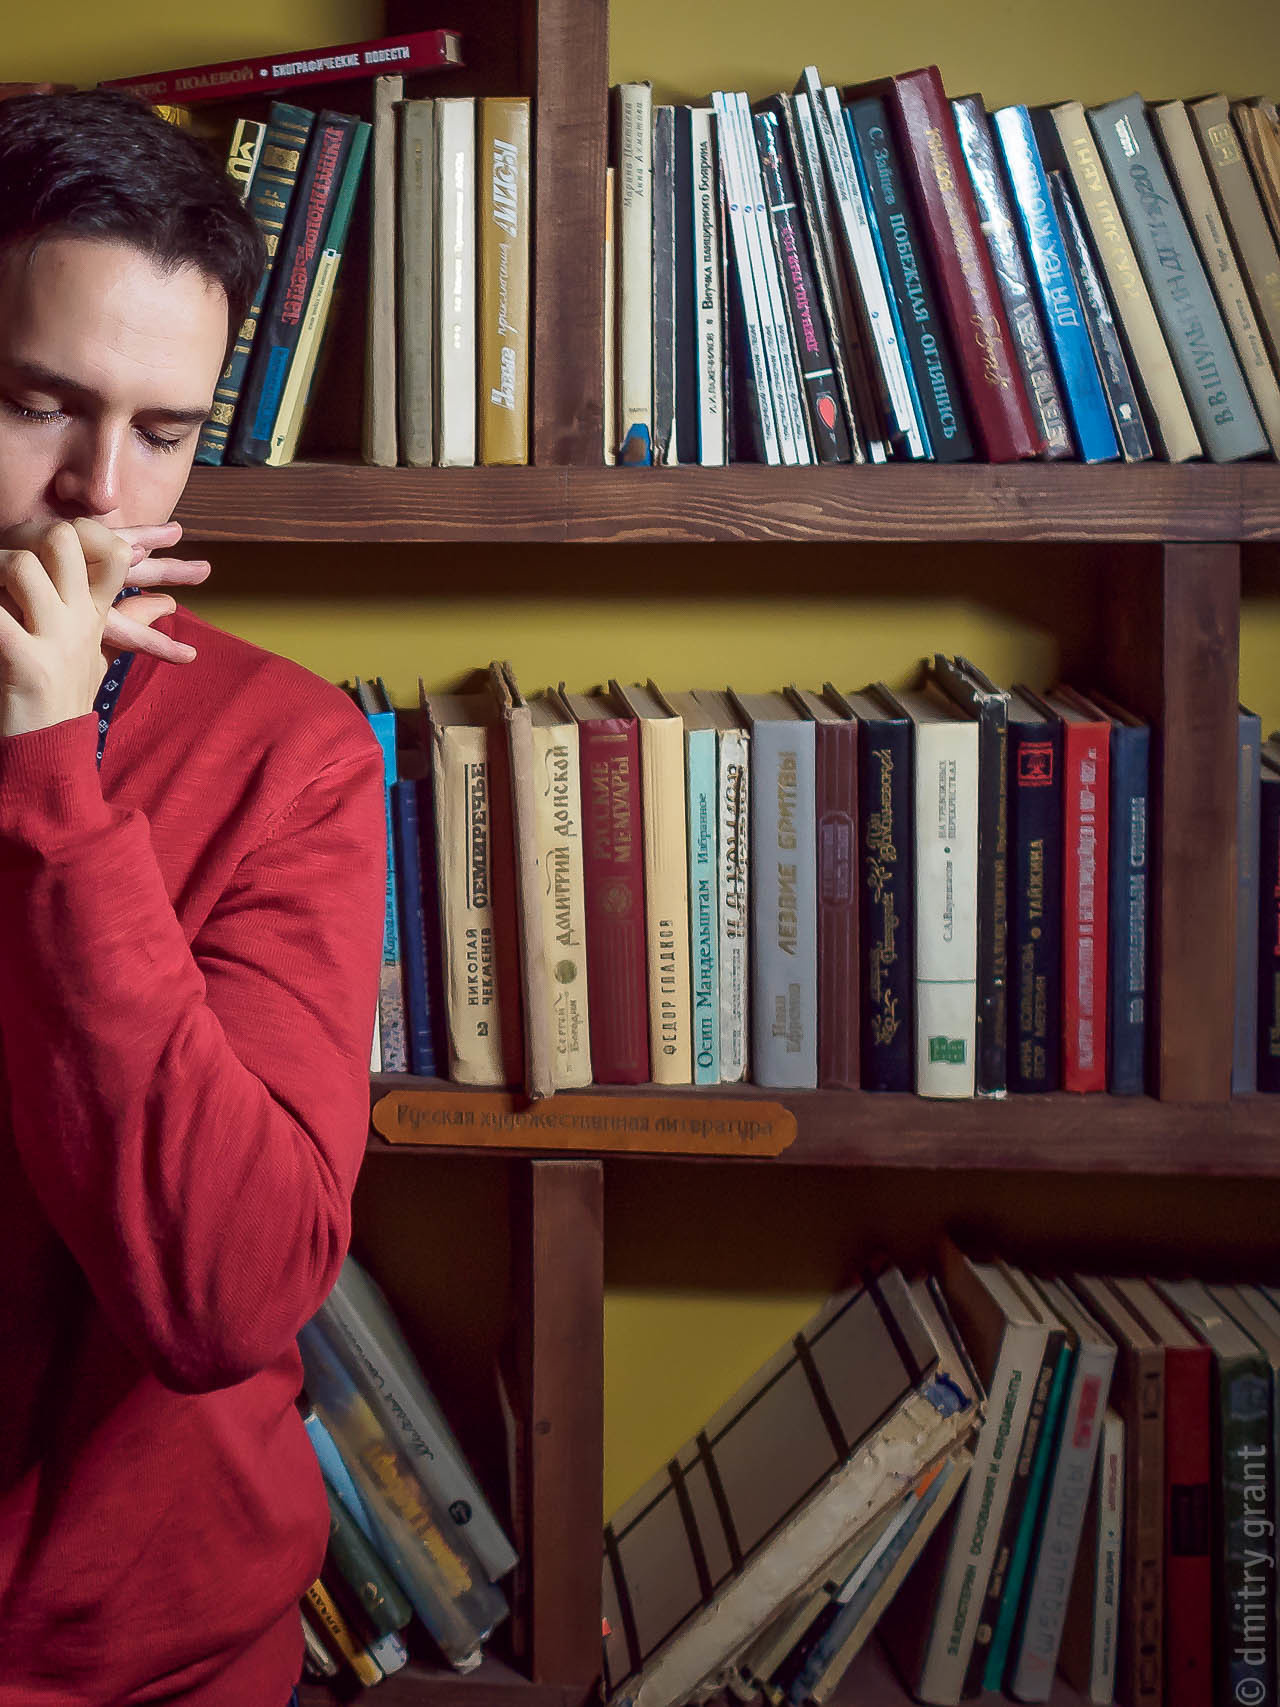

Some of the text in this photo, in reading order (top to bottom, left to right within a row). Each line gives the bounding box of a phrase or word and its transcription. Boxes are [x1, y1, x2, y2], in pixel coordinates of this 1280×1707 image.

[174, 66, 254, 93] ПОЛЕВОЙ
[364, 46, 411, 65] ПОВЕСТИ
[492, 139, 518, 239] АЛИСЫ
[624, 101, 634, 208] Марина Цветаева
[634, 101, 645, 198] Анна Ахматова
[872, 146, 898, 206] Зайцев
[701, 267, 714, 310] Внучка
[1050, 287, 1080, 328] ДЛЯ
[471, 762, 488, 910] СЕМИРЕЧЬЕ
[552, 744, 580, 948] ДМИТРИЙ ДОНСКОЙ
[591, 759, 610, 862] РУССКИЕ
[617, 755, 633, 865] МЕМУАРЫ
[777, 750, 798, 957] ЛЕЗВИЕ БРИТВЫ
[468, 926, 479, 1007] НИКОЛАЙ
[480, 926, 493, 1007] ЧЕКМЕНЕВ
[696, 791, 715, 1069] Осип Мандельштам Избранное
[659, 918, 677, 1056] ФЕДОР ГЛАДКОВ
[396, 1102, 775, 1141] Русская художественная литература
